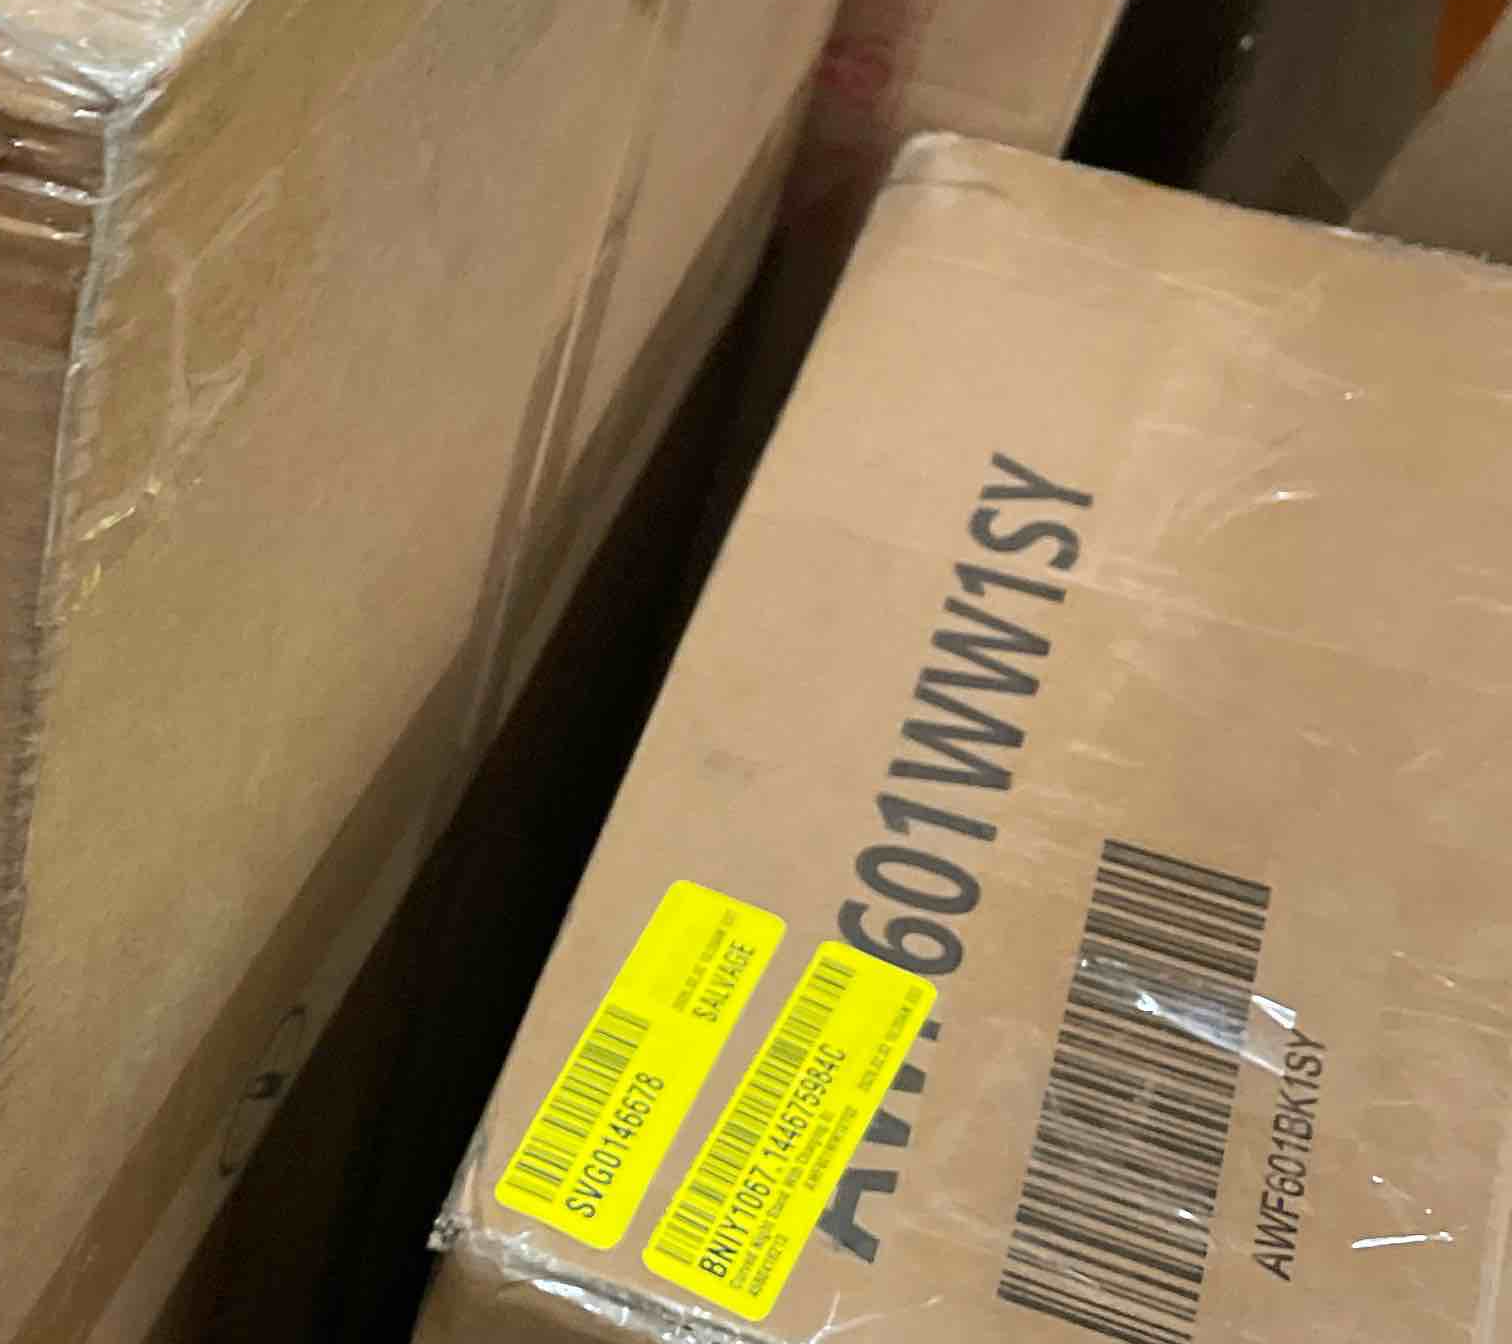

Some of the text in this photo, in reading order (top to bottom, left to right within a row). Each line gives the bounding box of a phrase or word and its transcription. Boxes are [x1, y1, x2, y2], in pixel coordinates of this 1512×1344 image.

[817, 452, 1094, 1265] A601WW1SY
[692, 938, 756, 1024] SALVAGE
[563, 1068, 667, 1220] SVG0146678
[1250, 1030, 1327, 1281] AWF601BK1SY
